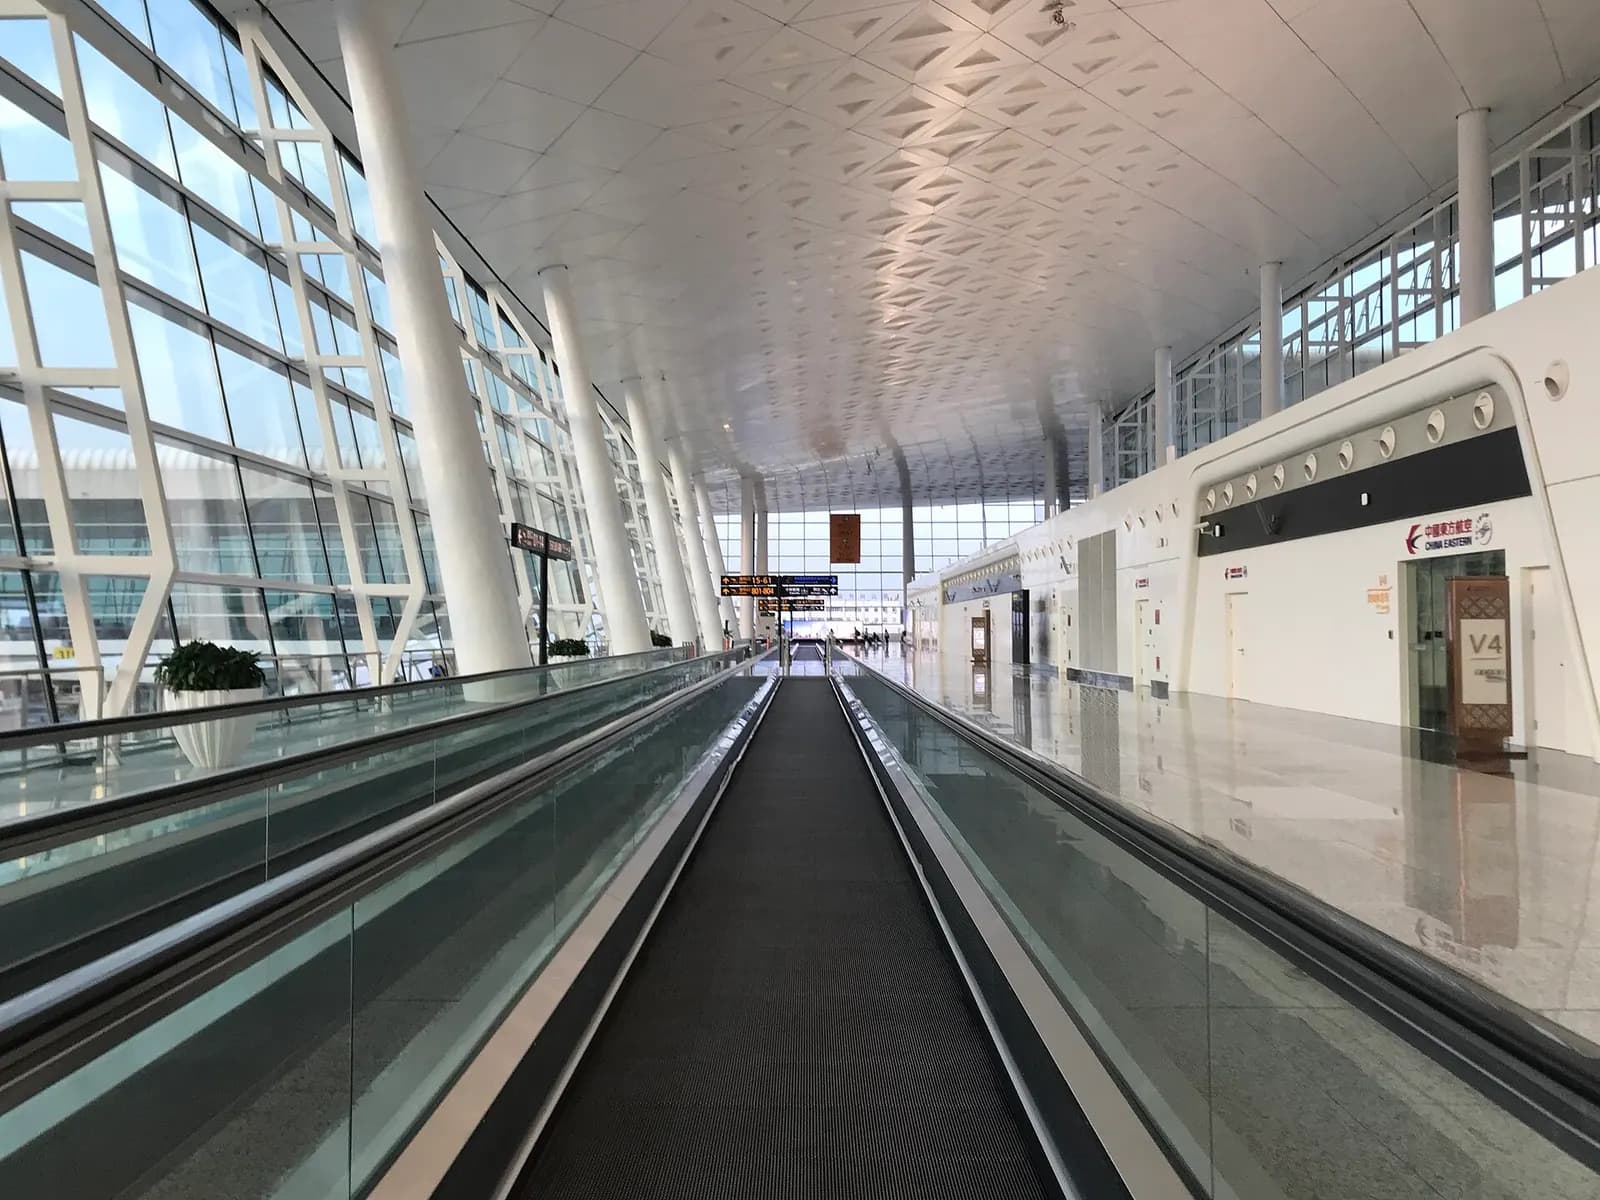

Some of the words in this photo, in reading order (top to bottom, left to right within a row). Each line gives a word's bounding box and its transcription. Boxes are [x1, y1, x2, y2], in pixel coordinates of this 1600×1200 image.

[1425, 541, 1442, 551] CHINA
[1444, 537, 1472, 549] EASTERN
[1469, 634, 1503, 654] V4
